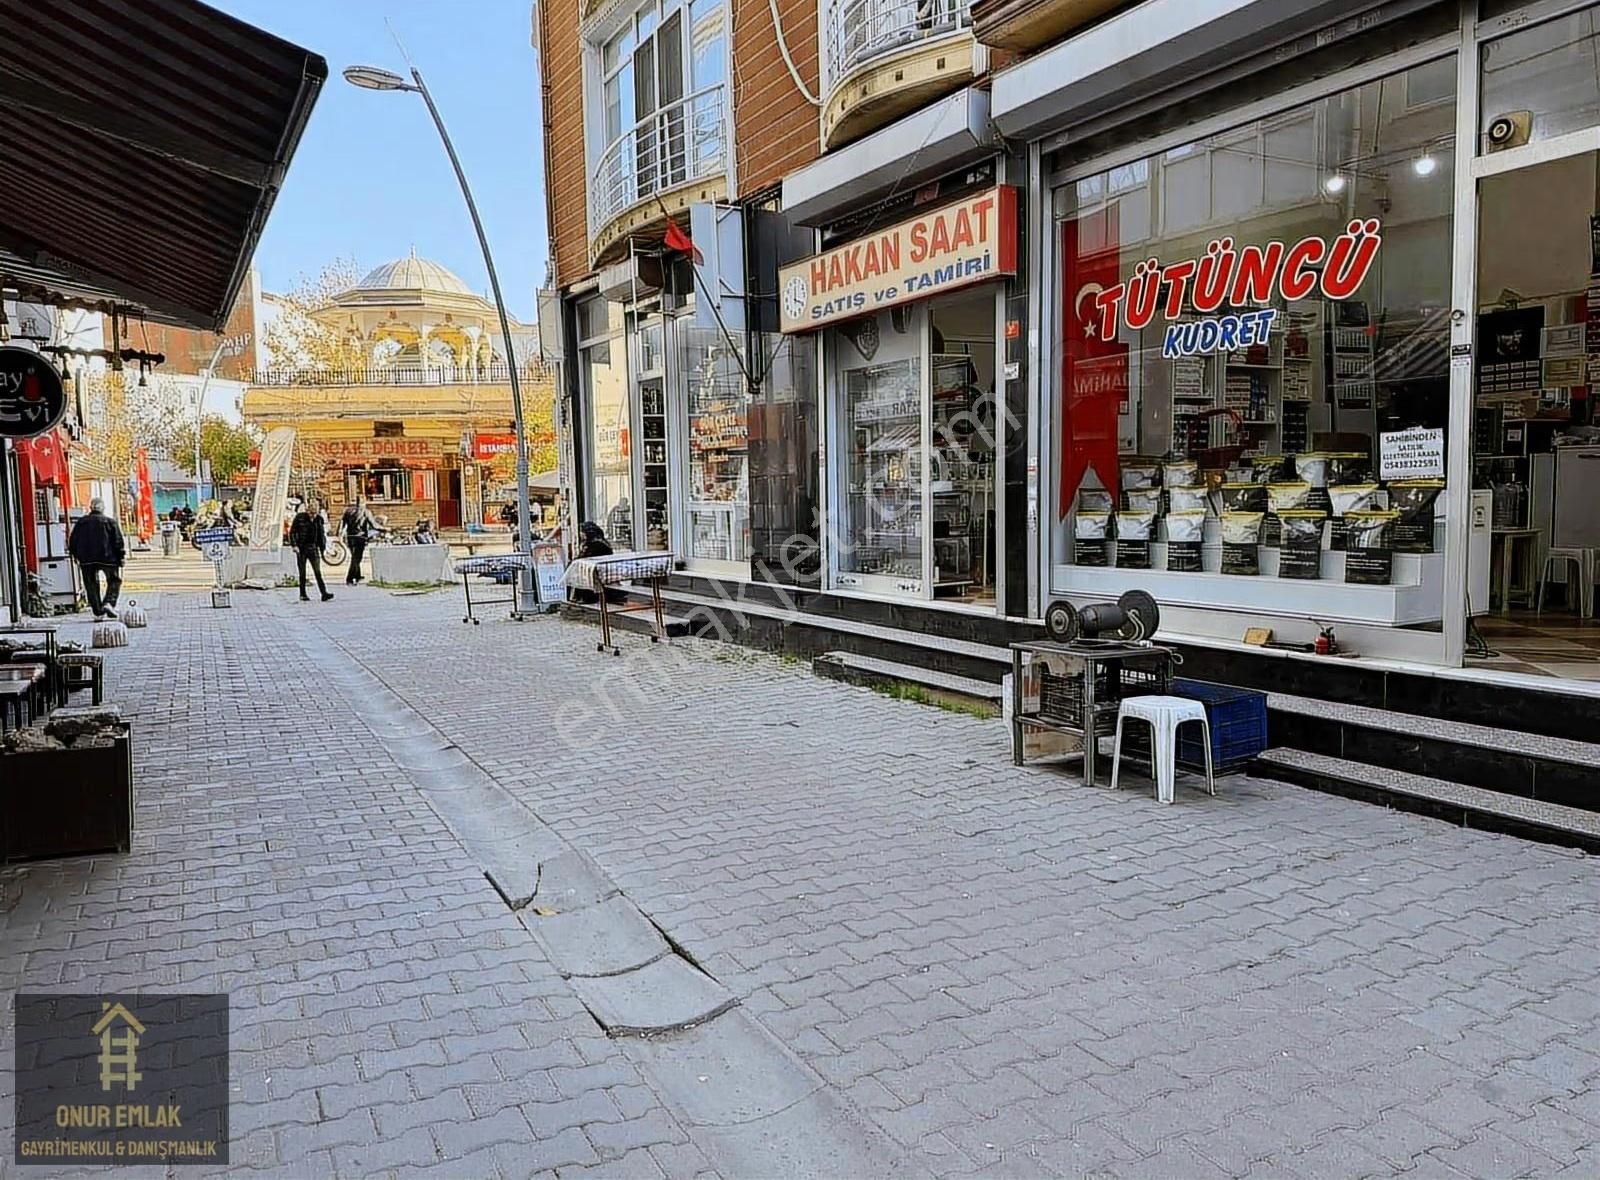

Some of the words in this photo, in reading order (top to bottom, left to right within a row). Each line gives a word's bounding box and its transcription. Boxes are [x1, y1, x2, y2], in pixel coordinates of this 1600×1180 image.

[810, 231, 900, 297] HAKAN
[909, 197, 994, 263] SAAT
[811, 291, 865, 320] SATIŞ
[874, 286, 897, 302] ve
[904, 249, 991, 292] TAMİRİ
[1096, 217, 1382, 342] TÜTÜNCÜ
[1162, 308, 1277, 359] KUDRET
